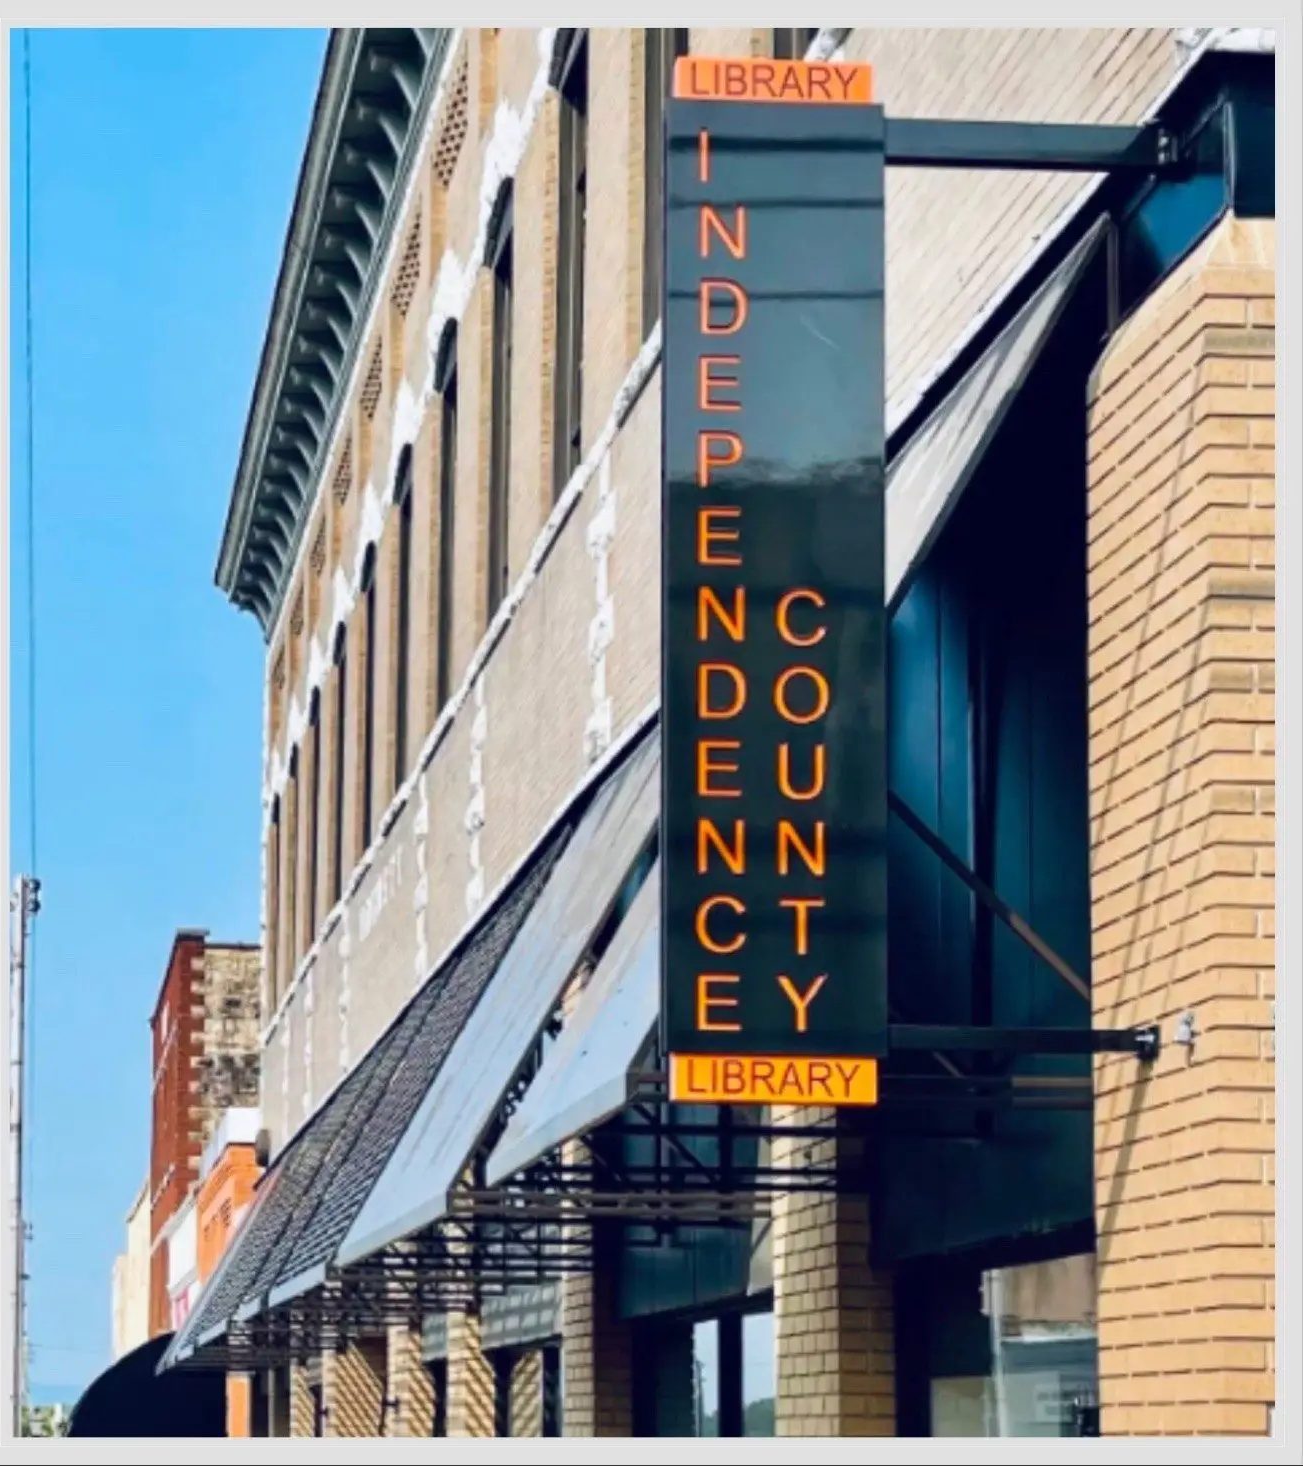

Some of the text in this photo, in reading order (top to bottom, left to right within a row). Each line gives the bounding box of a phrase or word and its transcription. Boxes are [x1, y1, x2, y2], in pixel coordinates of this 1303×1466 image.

[691, 61, 858, 100] LIBRARY
[695, 127, 749, 1032] INDEPENDENCE
[773, 587, 830, 1033] COUNTY
[686, 1058, 860, 1098] LIBRARY
